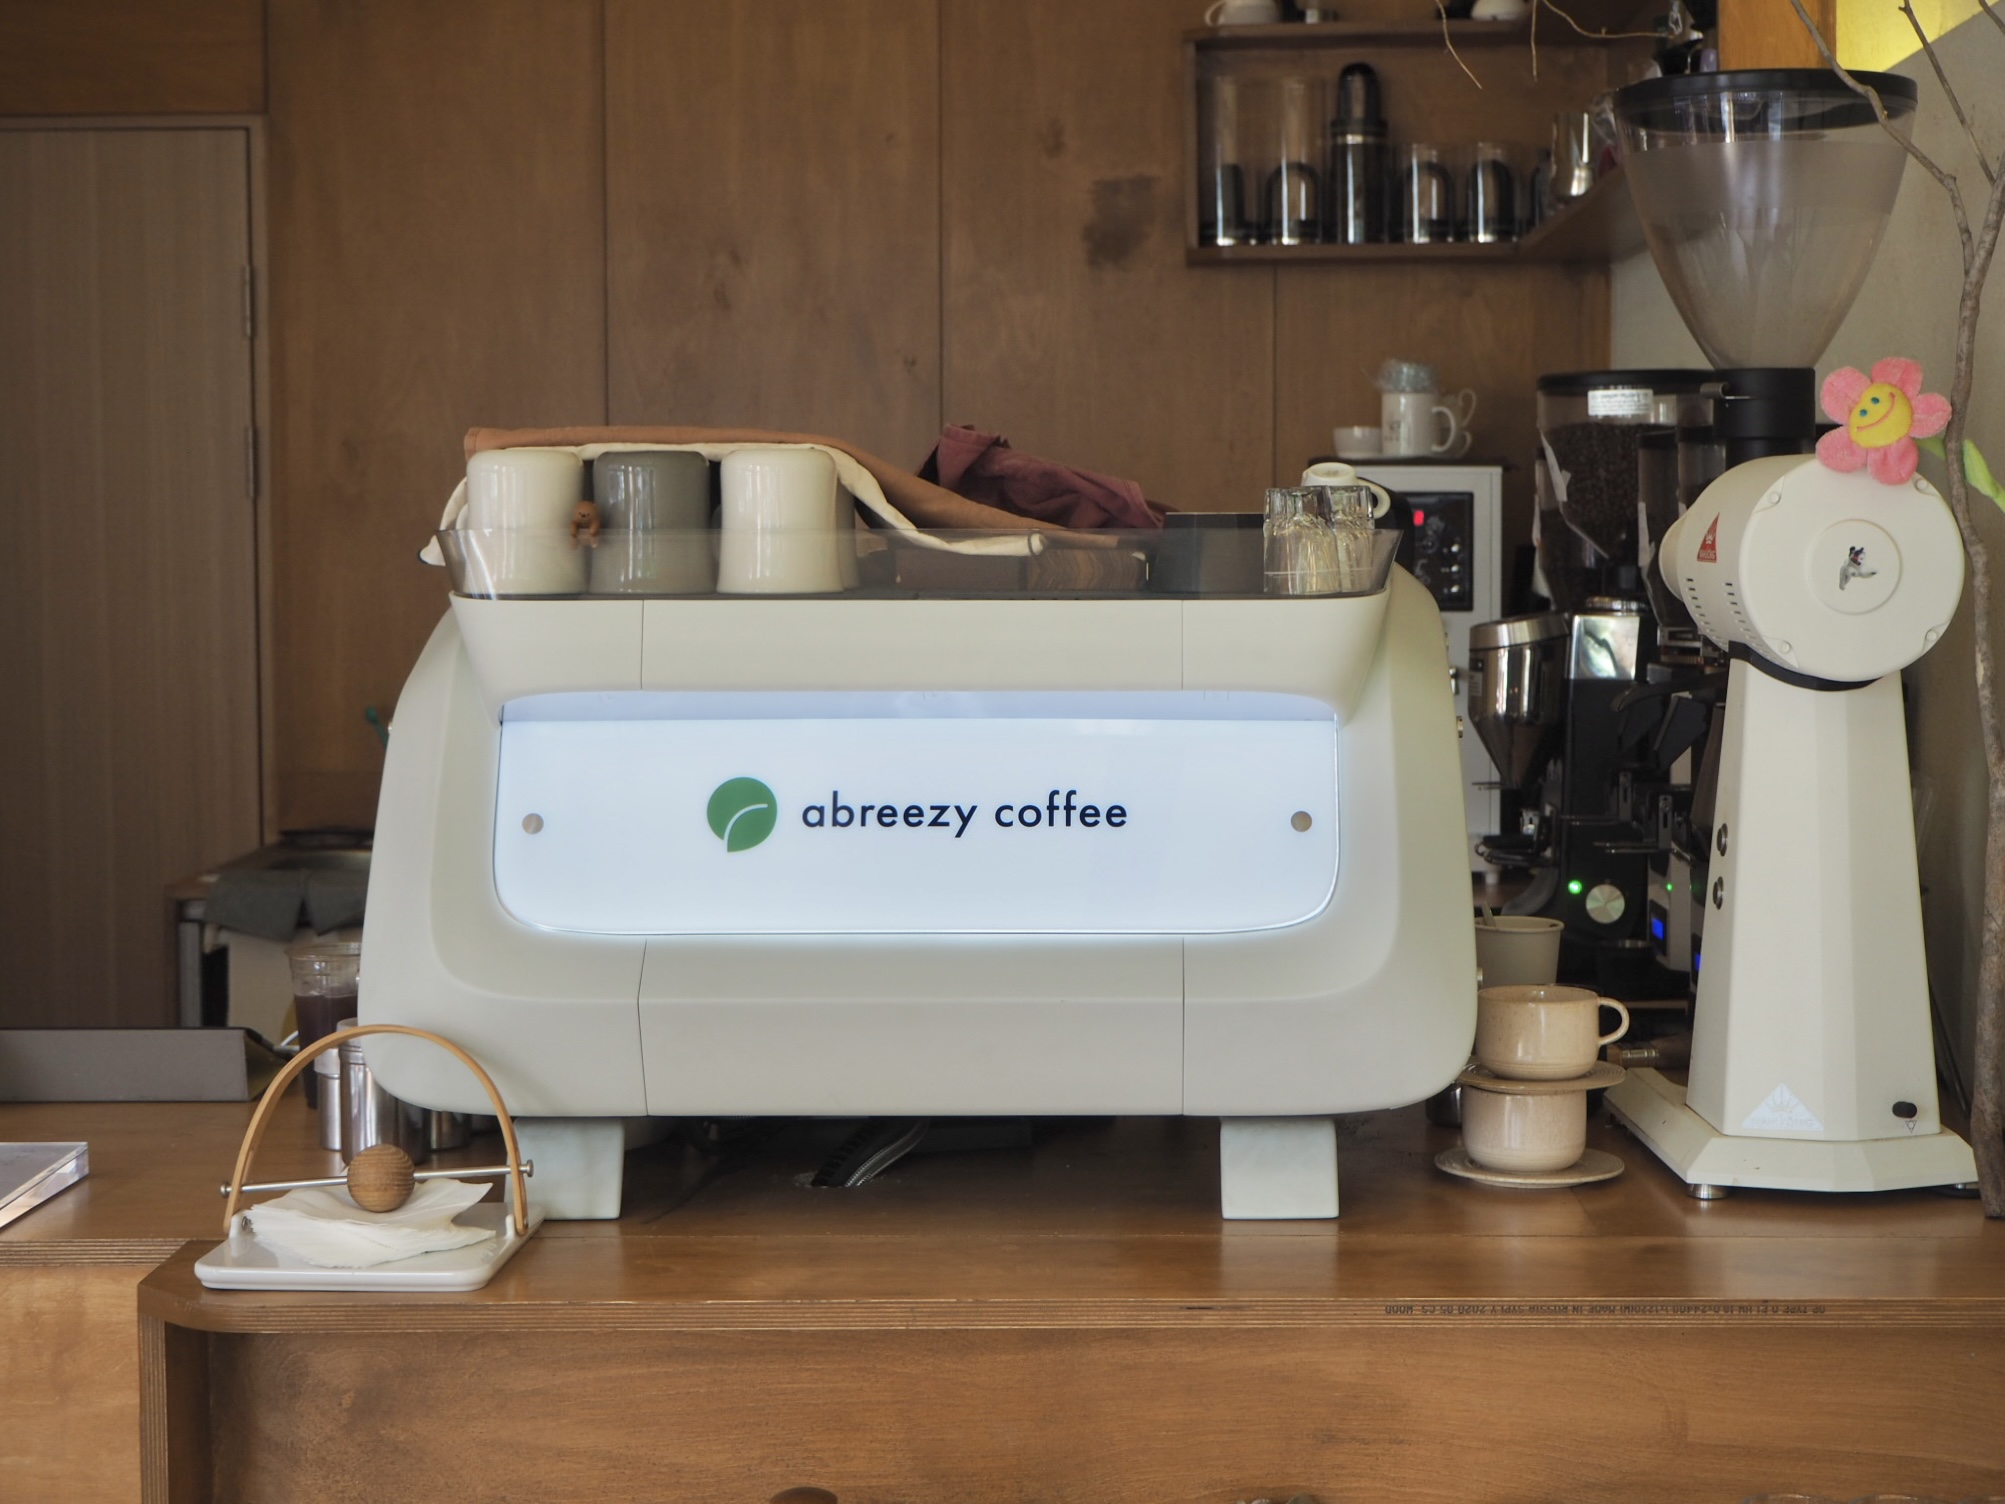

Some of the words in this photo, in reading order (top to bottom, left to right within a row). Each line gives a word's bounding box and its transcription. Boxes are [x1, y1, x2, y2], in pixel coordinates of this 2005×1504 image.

[801, 790, 978, 838] abreezy
[994, 789, 1128, 828] coffee
[1385, 1305, 1414, 1314] WOOD
[1440, 1305, 1454, 1314] 05
[1457, 1305, 1487, 1314] 2020
[1528, 1305, 1568, 1314] RUSSIA
[1572, 1305, 1583, 1314] IN
[1588, 1305, 1616, 1314] MADE
